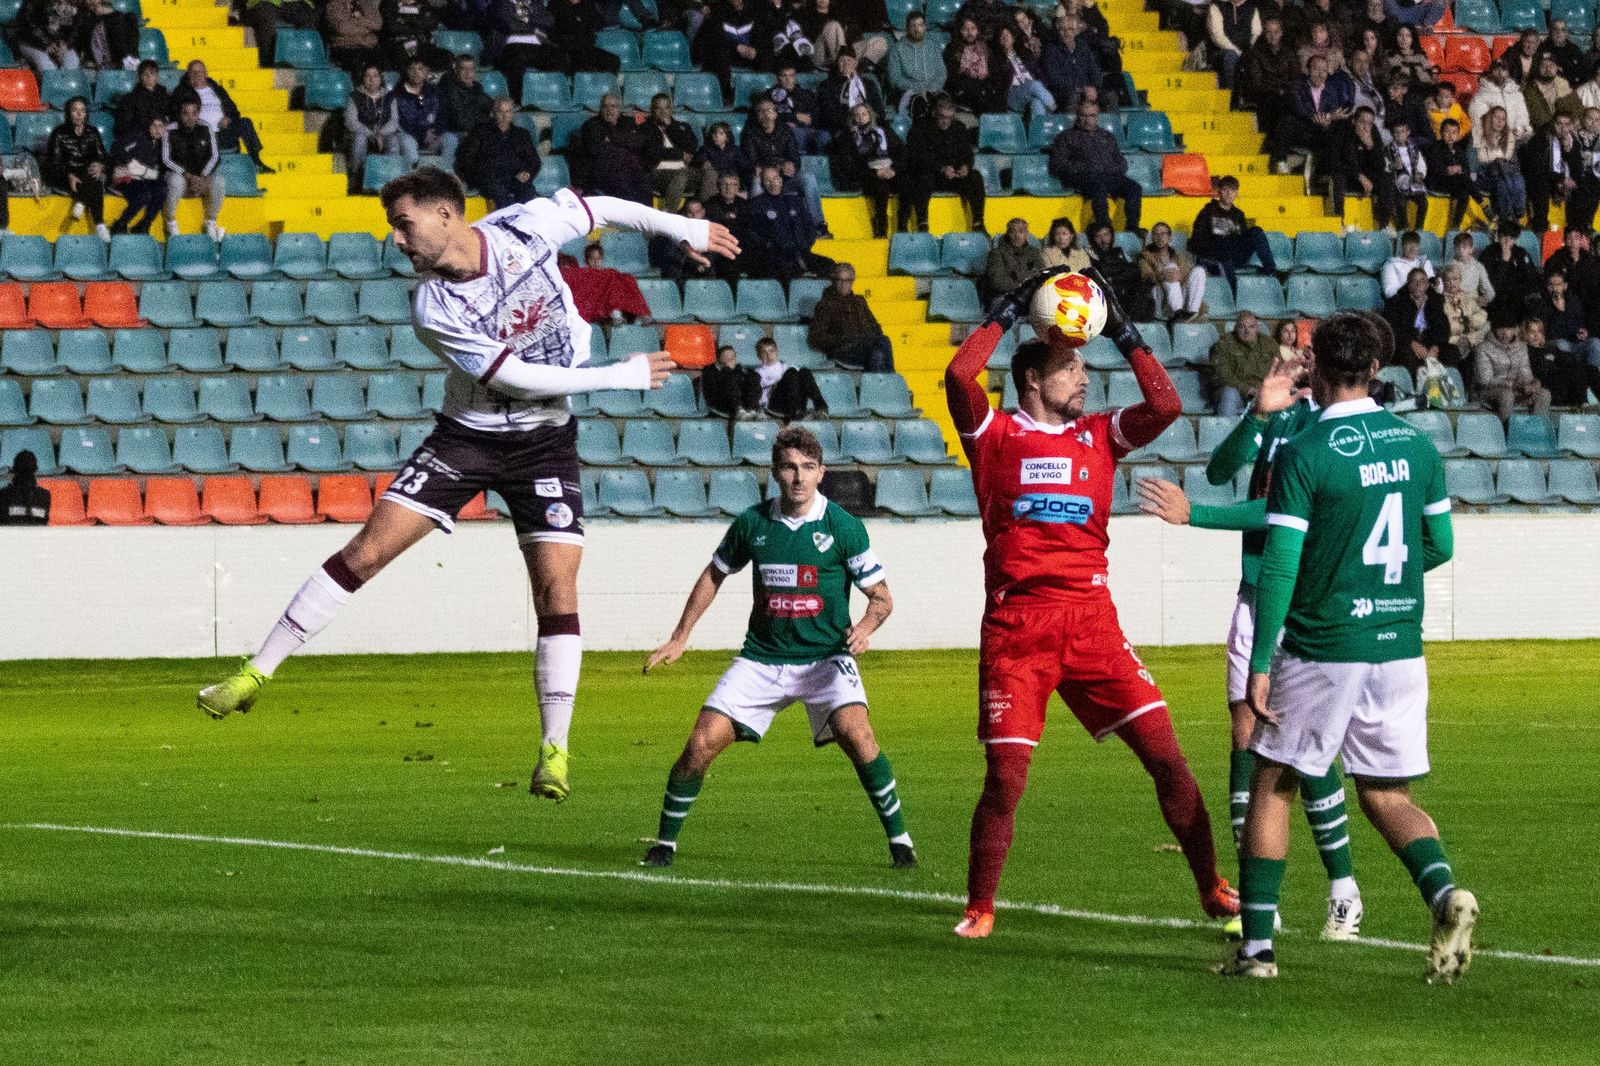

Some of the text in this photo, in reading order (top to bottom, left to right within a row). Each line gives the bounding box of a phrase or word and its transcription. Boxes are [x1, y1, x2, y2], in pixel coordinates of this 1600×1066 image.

[1328, 434, 1365, 449] NISSAN
[390, 466, 429, 495] 23
[1359, 458, 1410, 488] BORJA
[1031, 498, 1090, 515] doce
[1362, 491, 1409, 585] 4
[769, 598, 819, 611] doce
